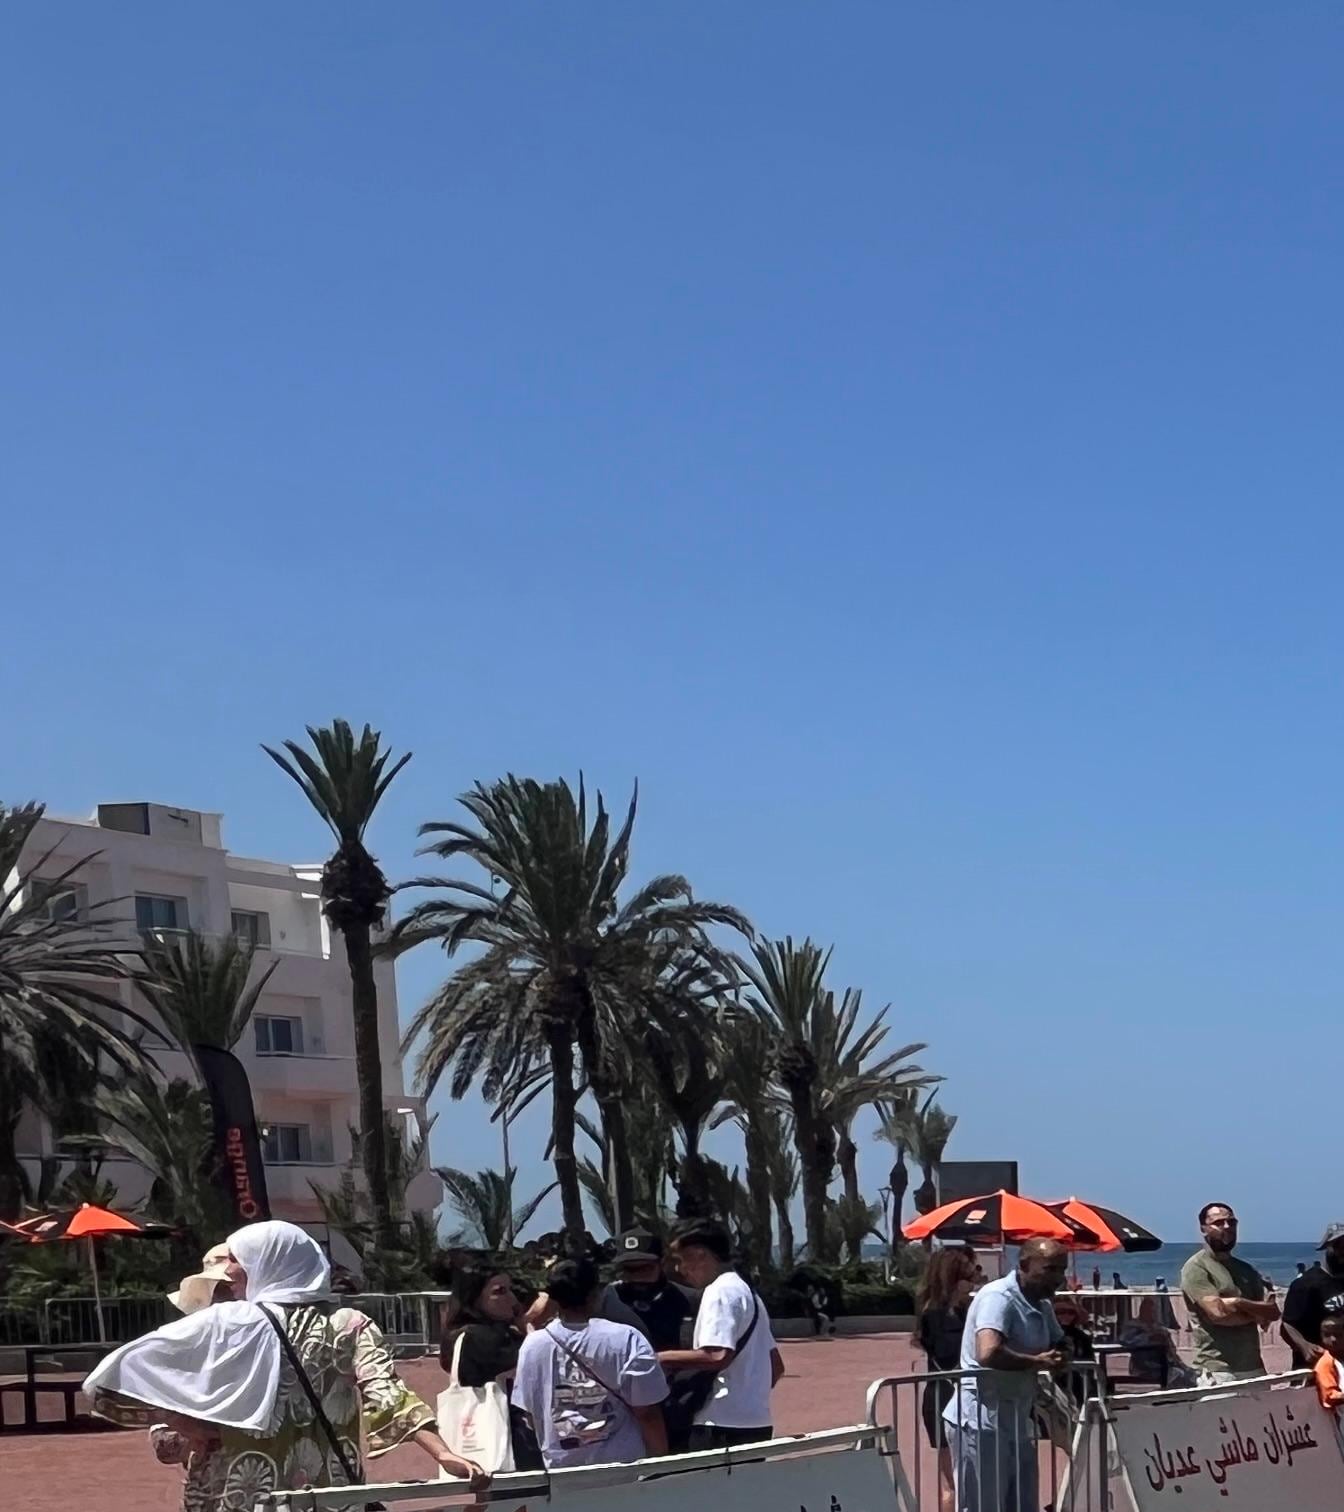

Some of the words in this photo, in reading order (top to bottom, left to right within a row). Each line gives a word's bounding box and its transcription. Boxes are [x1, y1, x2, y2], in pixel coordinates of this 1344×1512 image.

[1144, 1432, 1201, 1493] عديان
[1206, 1417, 1259, 1496] ماشي
[1263, 1405, 1319, 1467] عشران
